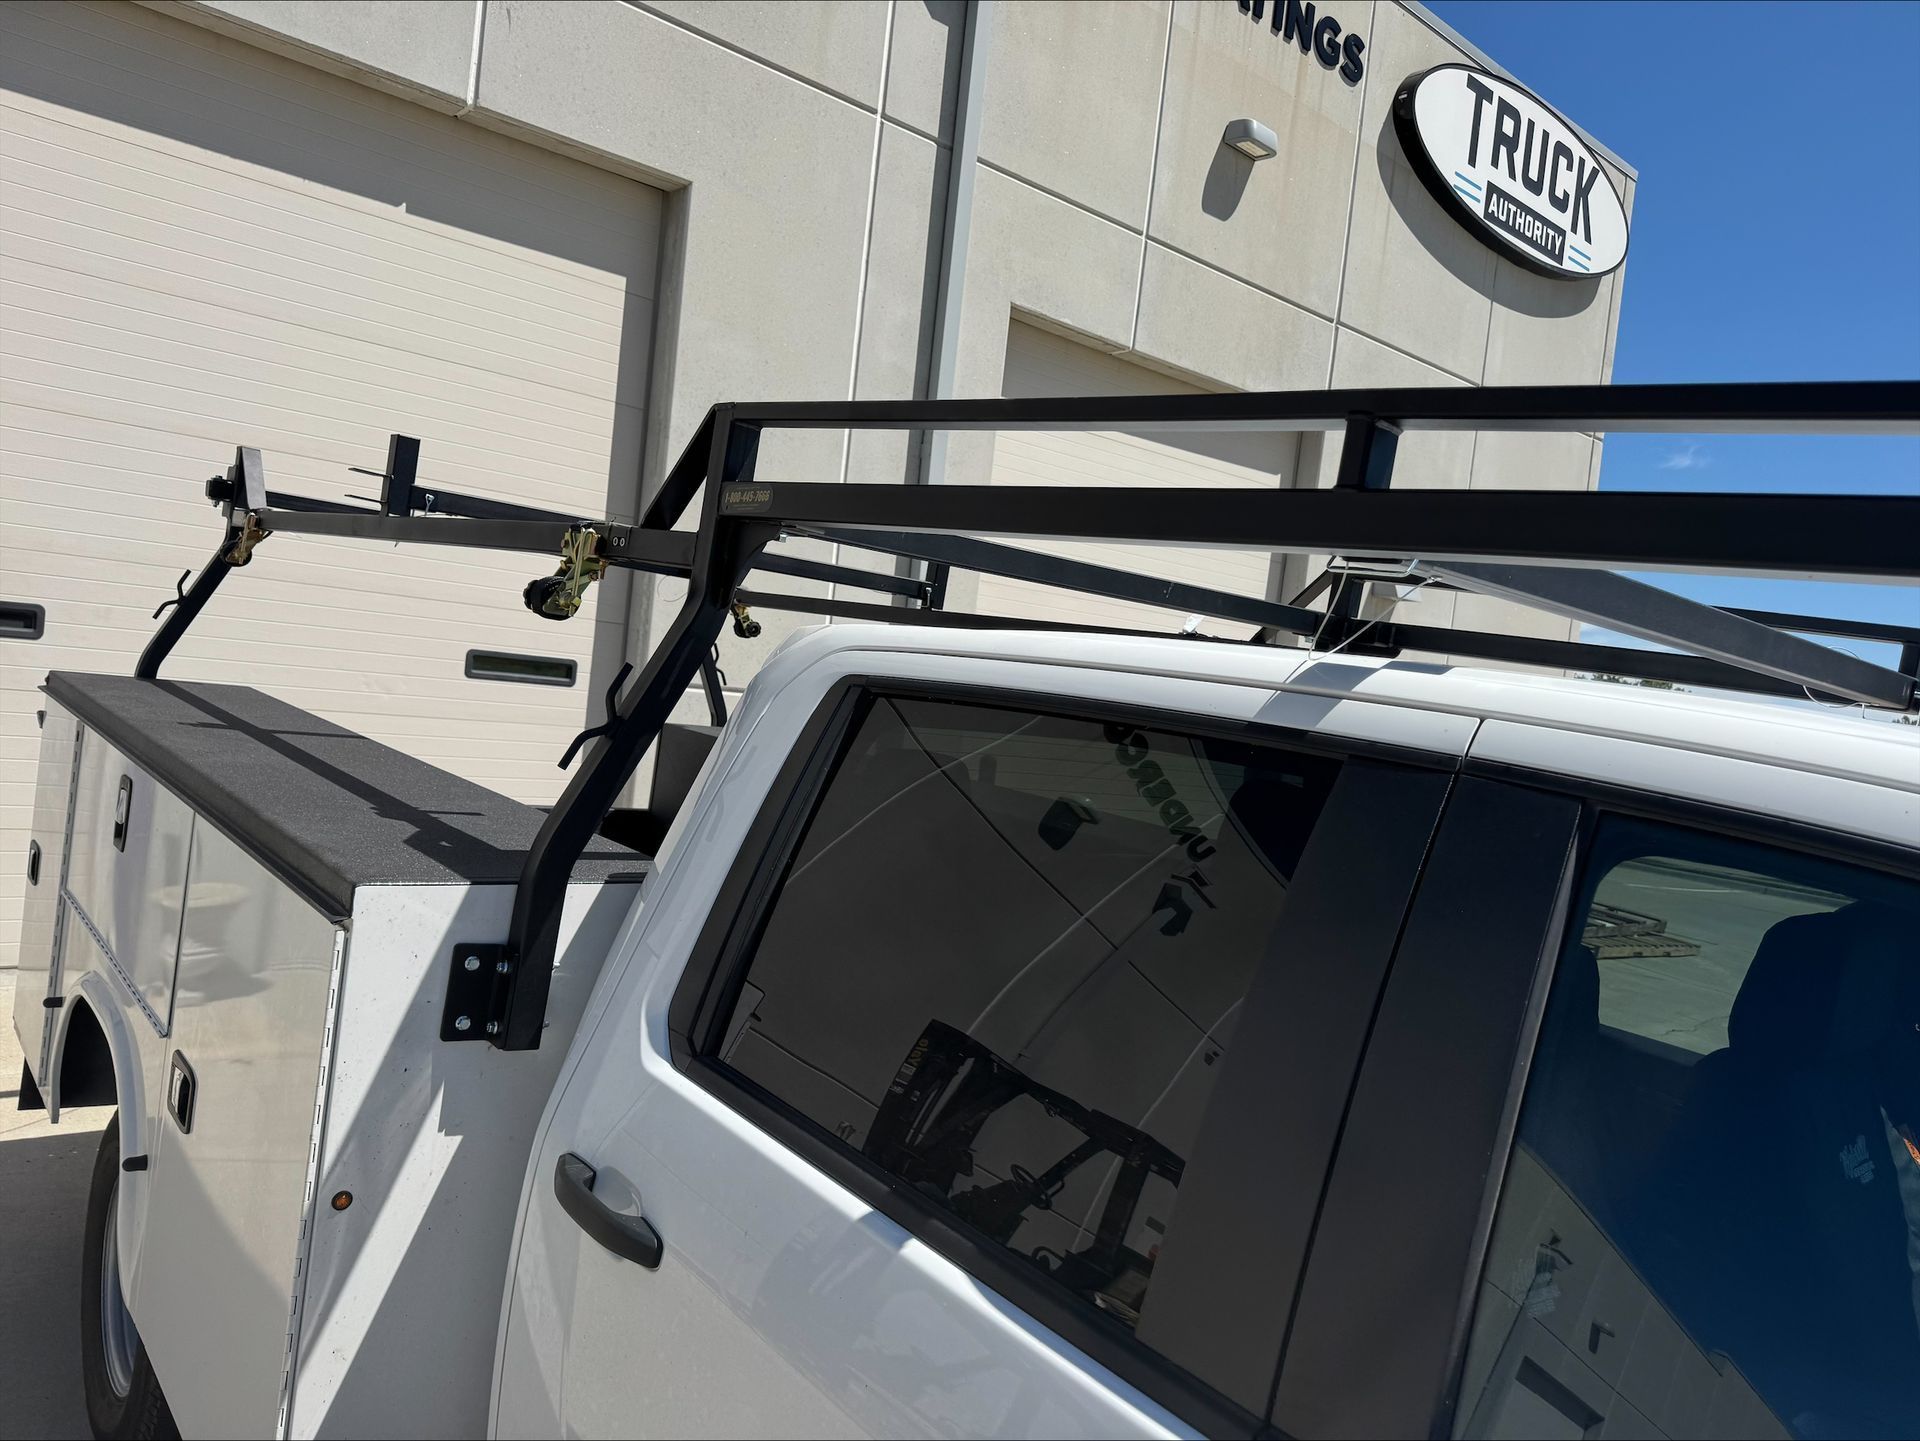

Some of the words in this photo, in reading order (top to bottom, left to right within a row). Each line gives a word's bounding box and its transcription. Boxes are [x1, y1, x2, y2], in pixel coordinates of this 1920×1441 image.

[1239, 0, 1365, 83] INGS
[1466, 73, 1600, 245] TRUCK
[1487, 193, 1563, 255] AUTHORITY
